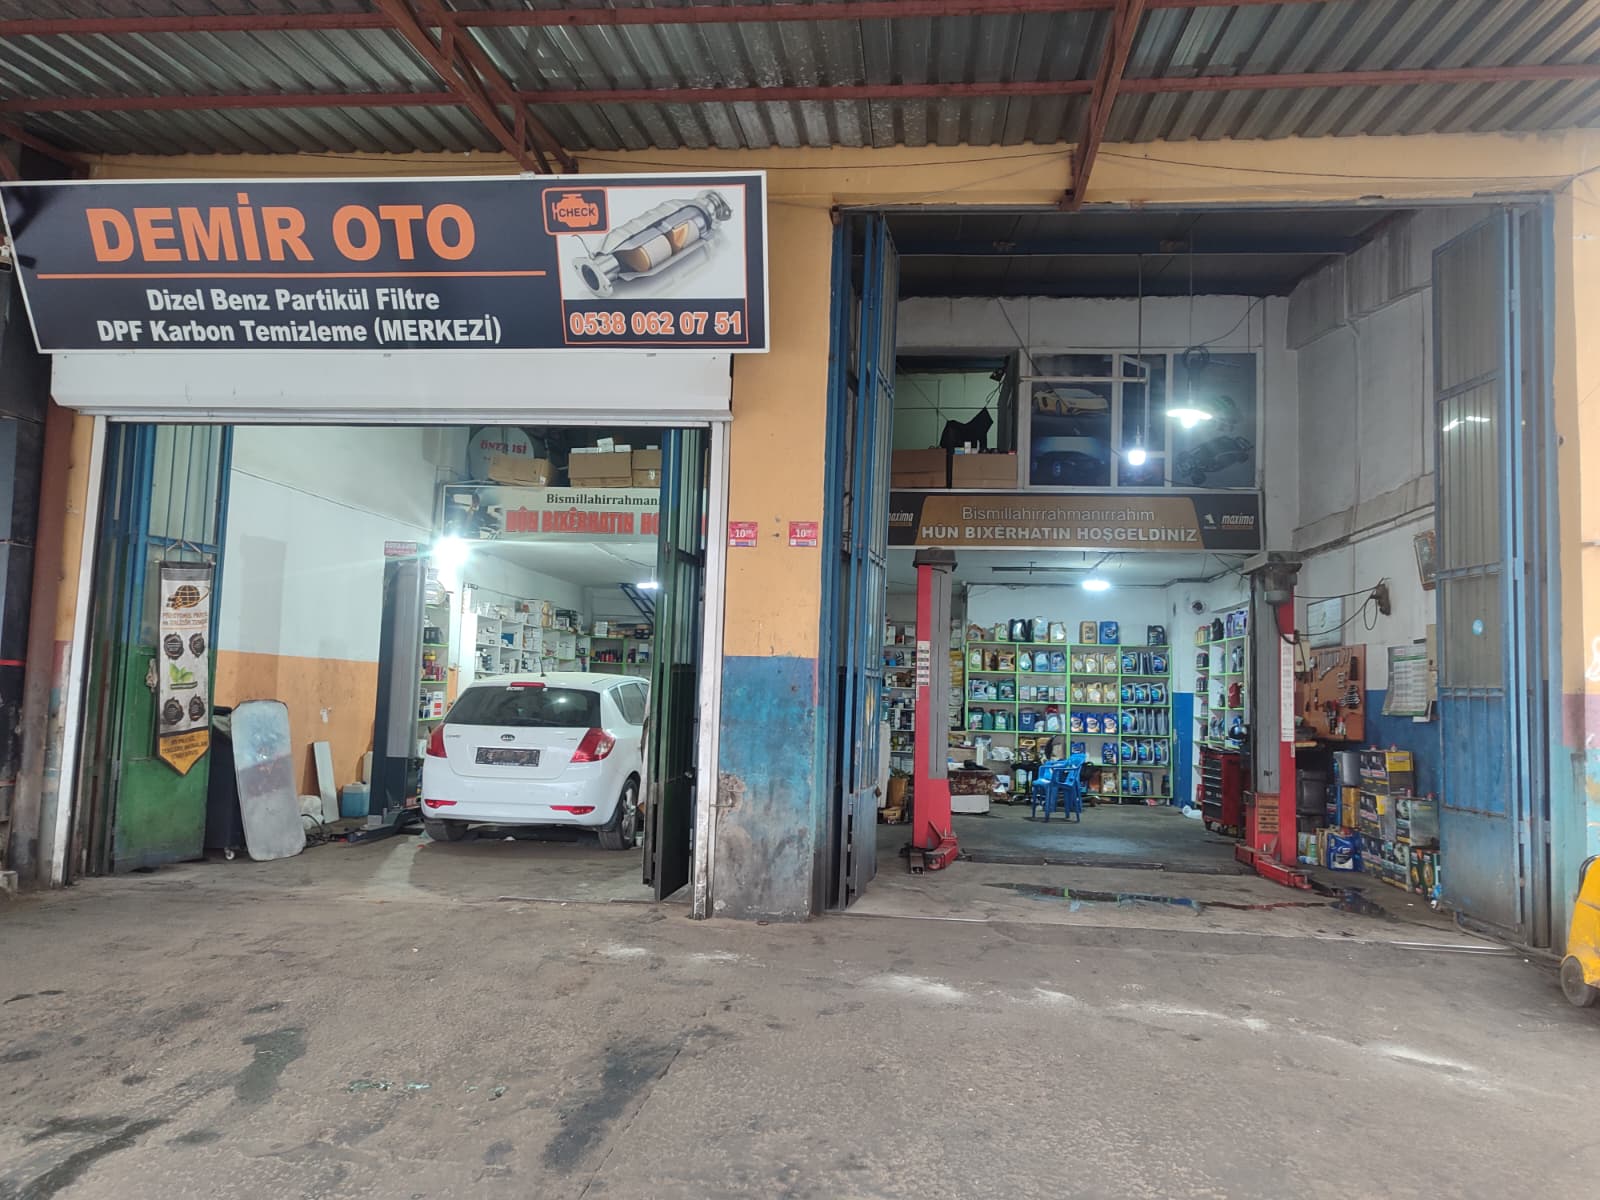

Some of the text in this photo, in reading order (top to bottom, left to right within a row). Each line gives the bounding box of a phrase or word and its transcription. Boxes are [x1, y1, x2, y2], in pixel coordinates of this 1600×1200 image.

[558, 206, 597, 218] CHECK
[86, 192, 476, 262] DEMİR OTO
[146, 287, 441, 311] Dizel Benz Partikül Filtre
[96, 313, 502, 345] DPF Karbon Temizleme (MERKEZİ)
[569, 310, 742, 336] 0538 062 07 51
[546, 493, 659, 506] Bismillahirrahman
[1222, 512, 1255, 526] maxima
[1077, 526, 1198, 543] HOŞGELDİNİZ
